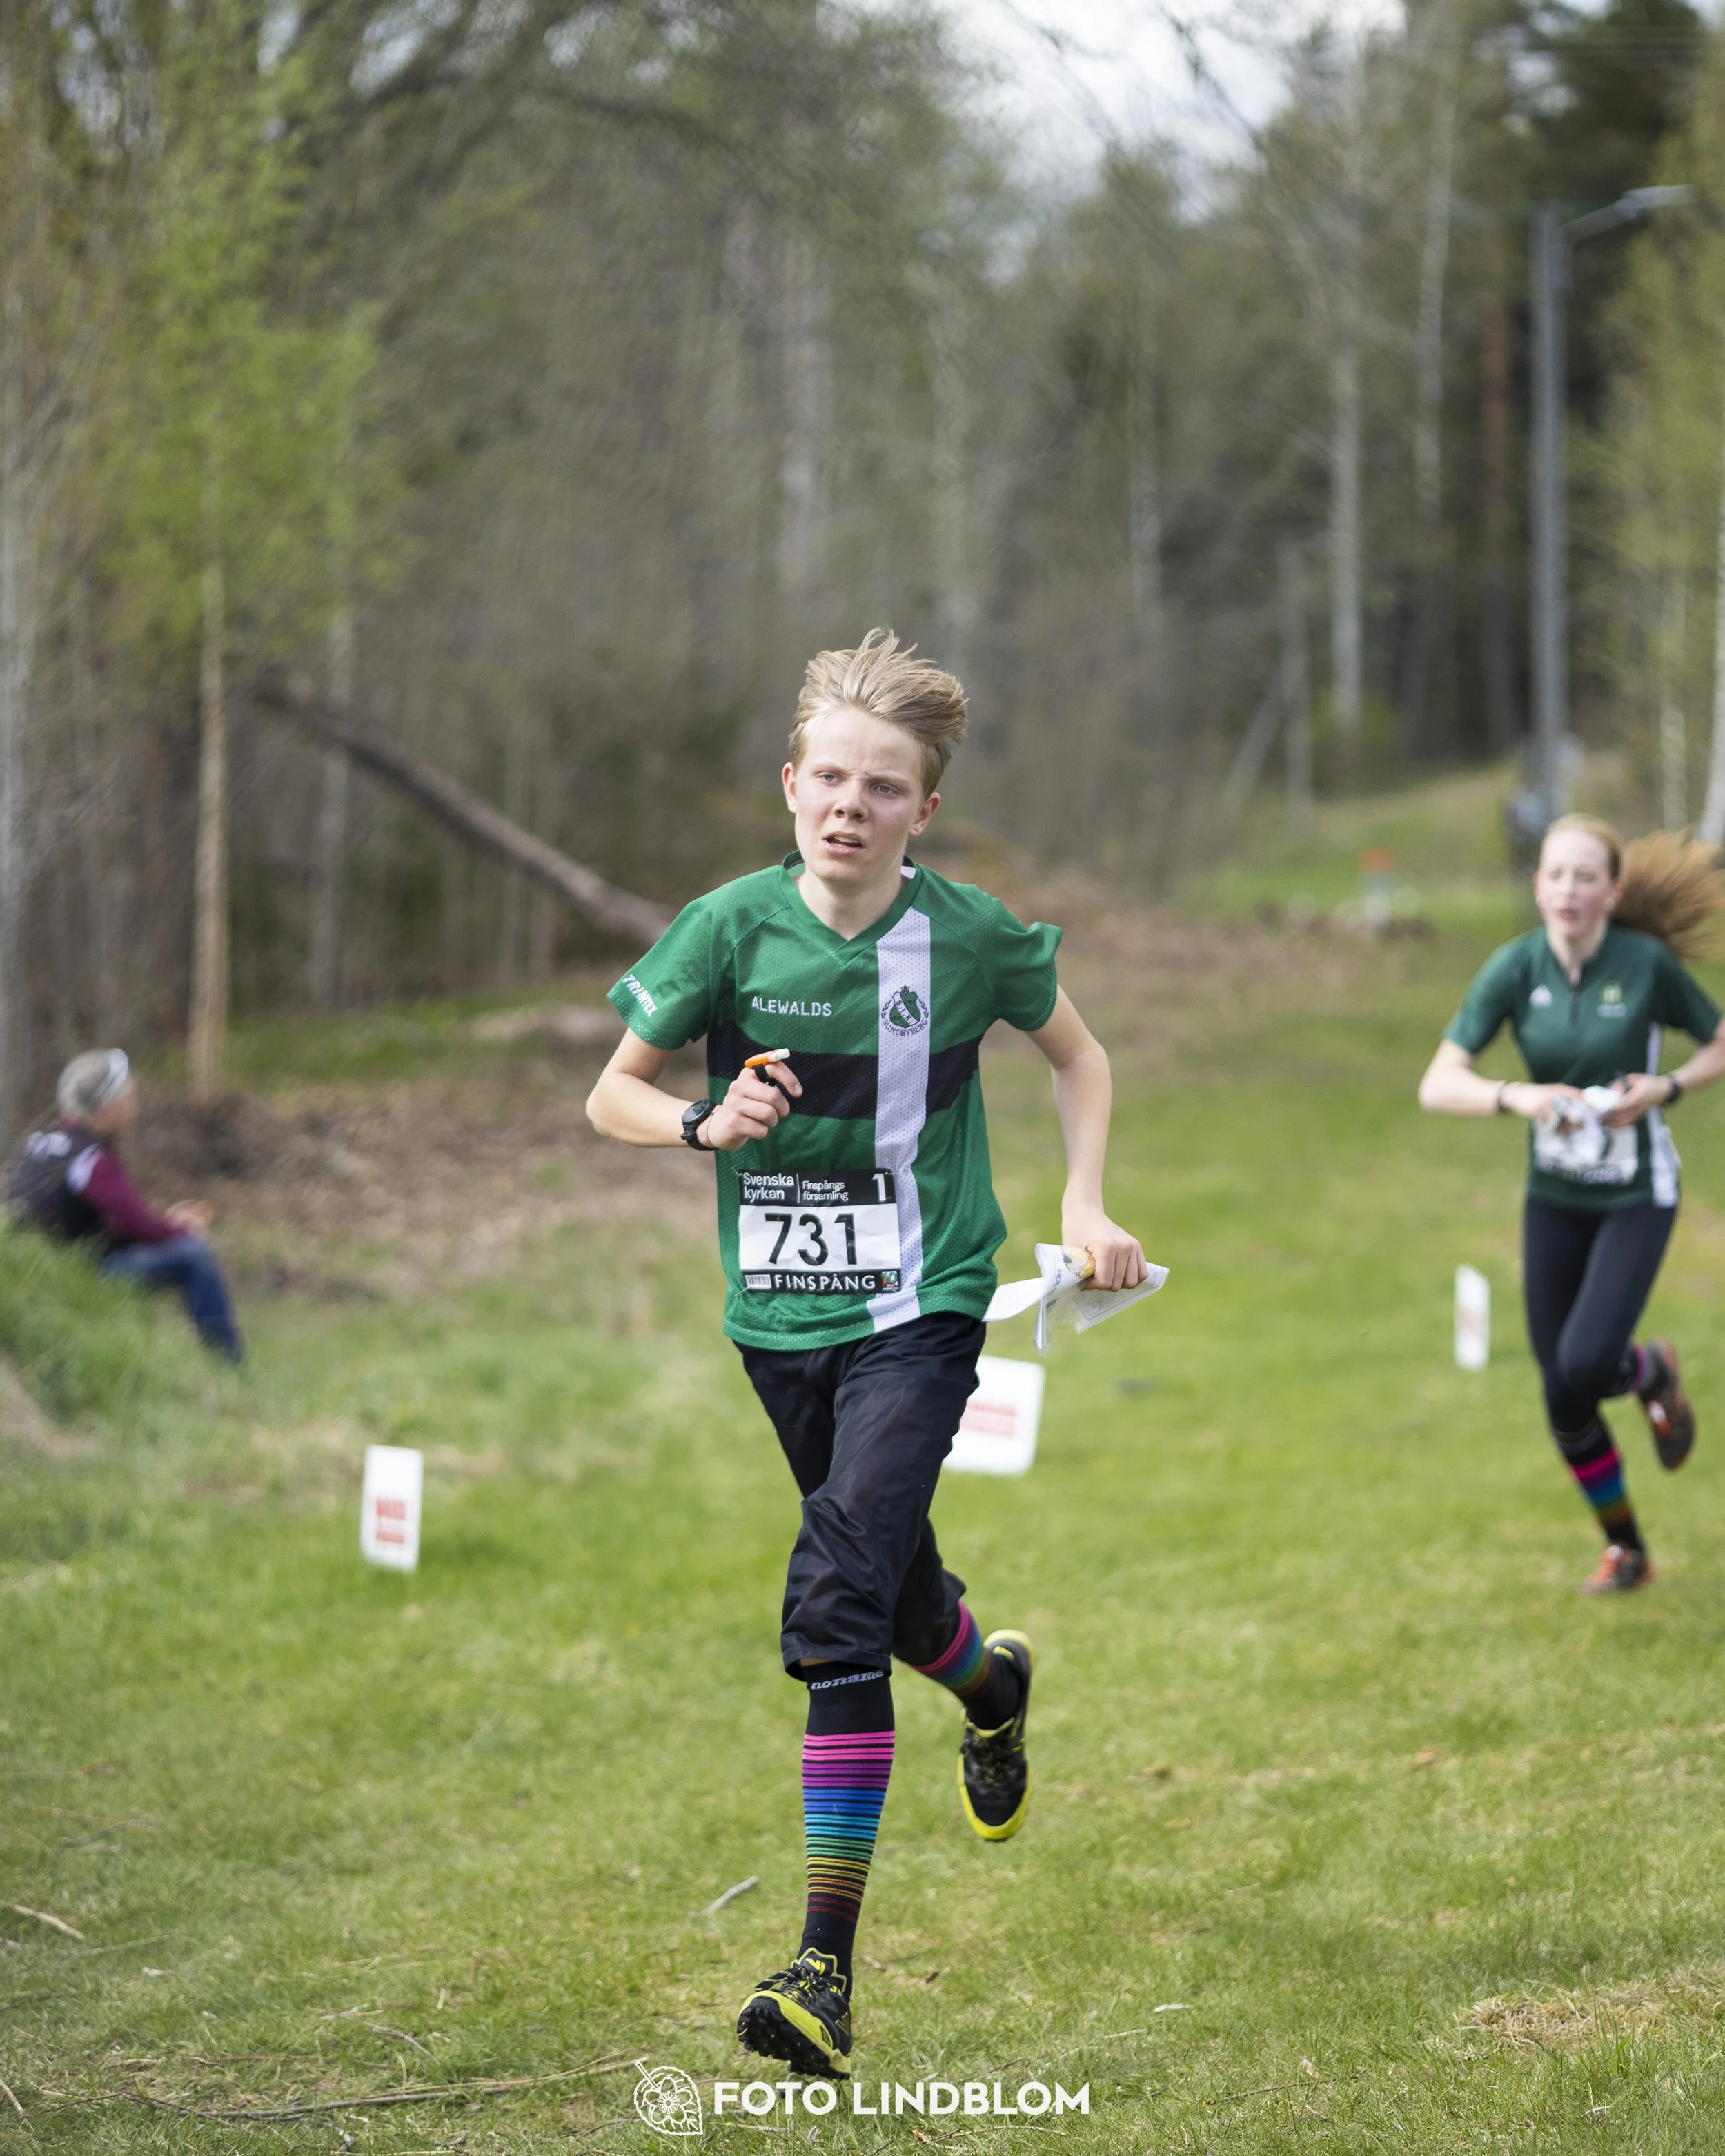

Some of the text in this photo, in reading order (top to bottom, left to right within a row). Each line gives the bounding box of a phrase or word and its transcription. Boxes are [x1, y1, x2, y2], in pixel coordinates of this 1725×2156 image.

[622, 973, 658, 1016] TRIMTEX
[752, 996, 832, 1016] ALEWALDS
[882, 1018, 928, 1036] SUNDBYBERG
[743, 1172, 794, 1186] Svenska
[802, 1180, 845, 1191] Finspångs
[871, 1173, 887, 1201] 1
[743, 1186, 785, 1203] kyrkan
[803, 1191, 849, 1202] församling
[764, 1212, 858, 1266] 731
[774, 1273, 876, 1291] FINSPÅNG
[811, 1669, 884, 1690] noname
